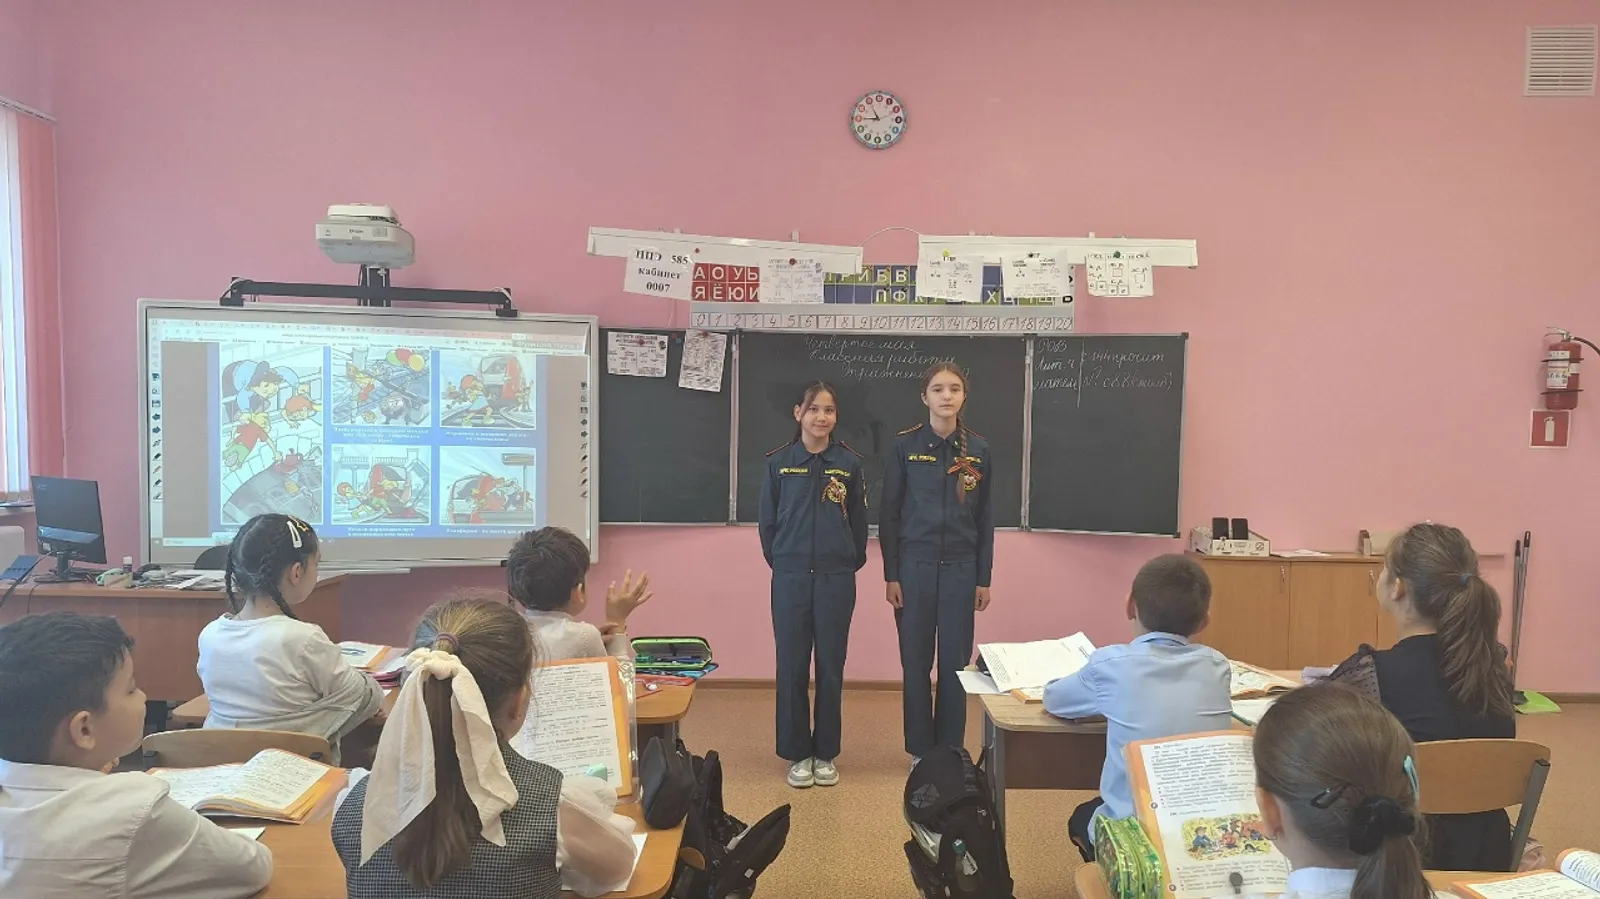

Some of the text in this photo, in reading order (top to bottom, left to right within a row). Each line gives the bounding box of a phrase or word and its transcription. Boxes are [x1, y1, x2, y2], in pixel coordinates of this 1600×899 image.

[636, 249, 689, 265] ППЭ 585
[638, 267, 681, 280] кабинет
[694, 266, 706, 279] А
[711, 266, 725, 280] О
[733, 267, 744, 280] У
[877, 268, 887, 283] Б
[895, 268, 907, 283] В
[646, 281, 671, 293] 0007
[695, 286, 706, 299] Я
[713, 283, 723, 300] Ё
[728, 286, 744, 300] Ю
[876, 288, 887, 303] П
[892, 288, 907, 303] Ф
[696, 314, 1072, 331] 0 1 2 3 4 5 6 7 8 9 10 11 12 13 14 15 16 17 18 19 20
